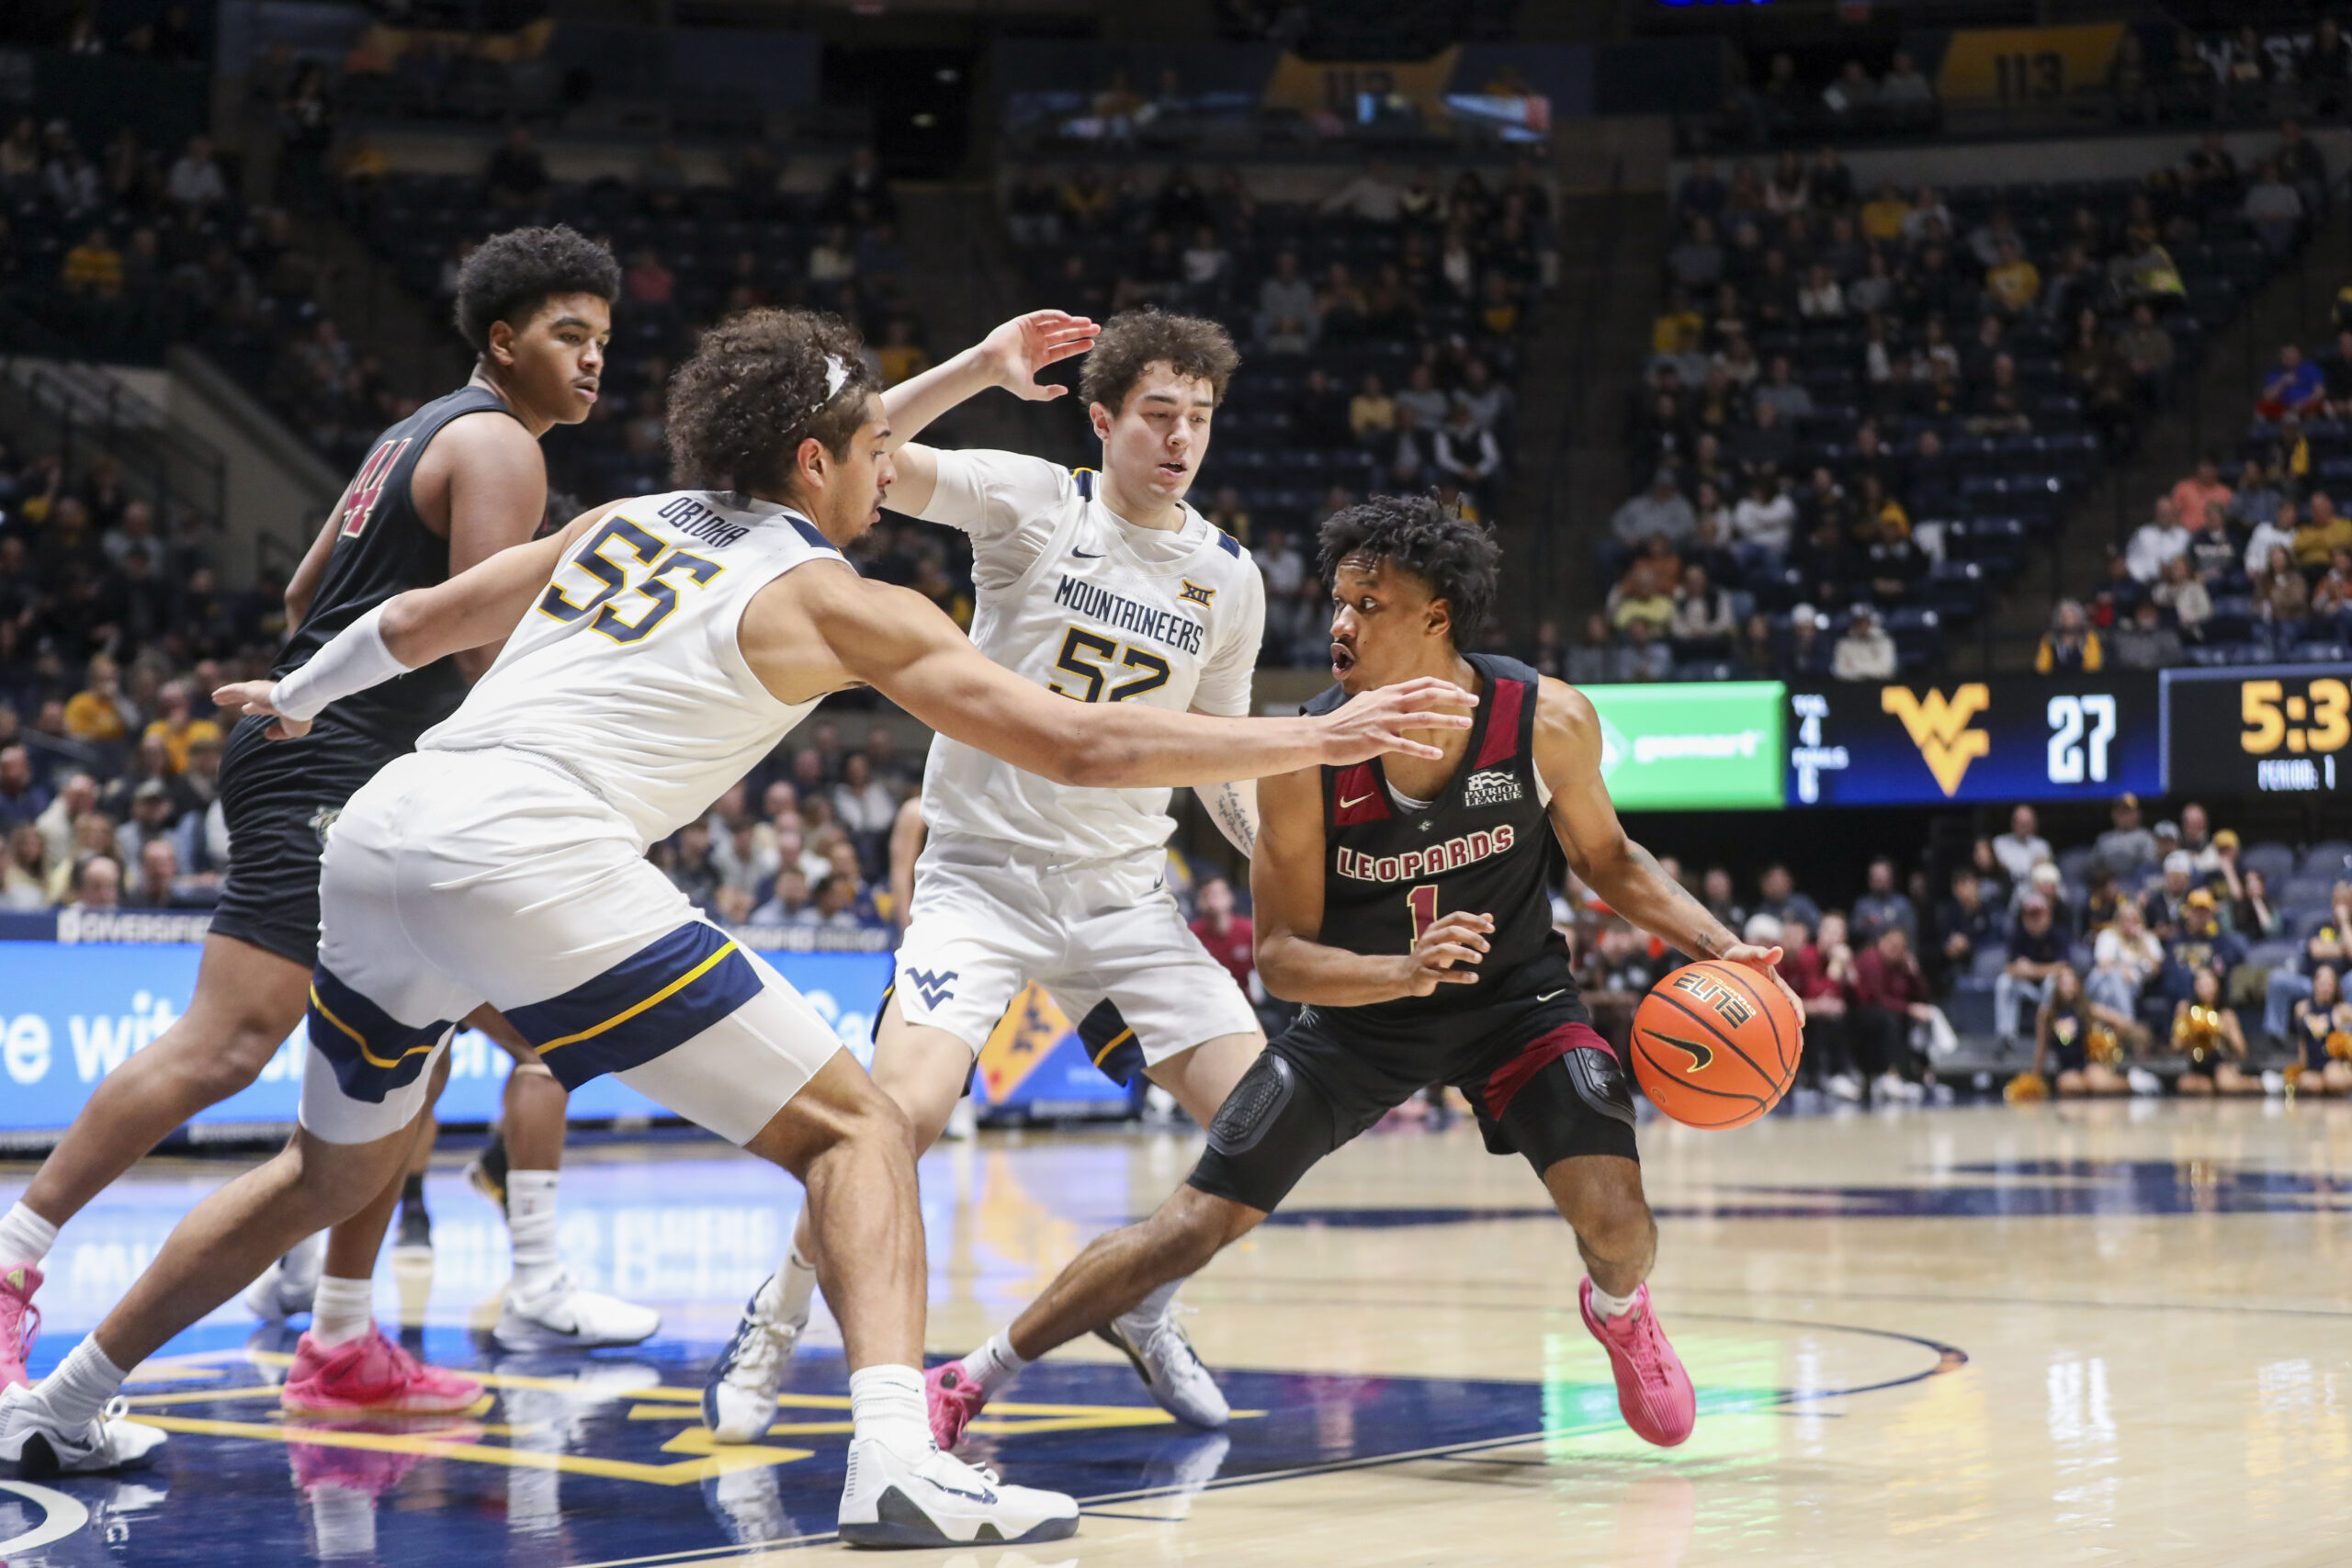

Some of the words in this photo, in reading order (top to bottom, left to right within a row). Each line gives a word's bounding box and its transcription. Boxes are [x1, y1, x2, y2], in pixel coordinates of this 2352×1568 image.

[1995, 51, 2064, 98] 113
[537, 514, 727, 646] 55
[1054, 574, 1204, 656] MOUNTAINEERS
[1048, 625, 1171, 703] 52
[2047, 695, 2116, 784] 27
[2241, 678, 2352, 755] 5:3
[1464, 783, 1521, 799] PATRIOT
[1465, 792, 1522, 807] LEAGUE
[1337, 824, 1514, 883] LEOPARDS
[1406, 884, 1439, 954] 1
[1673, 972, 1751, 1030] ELITE
